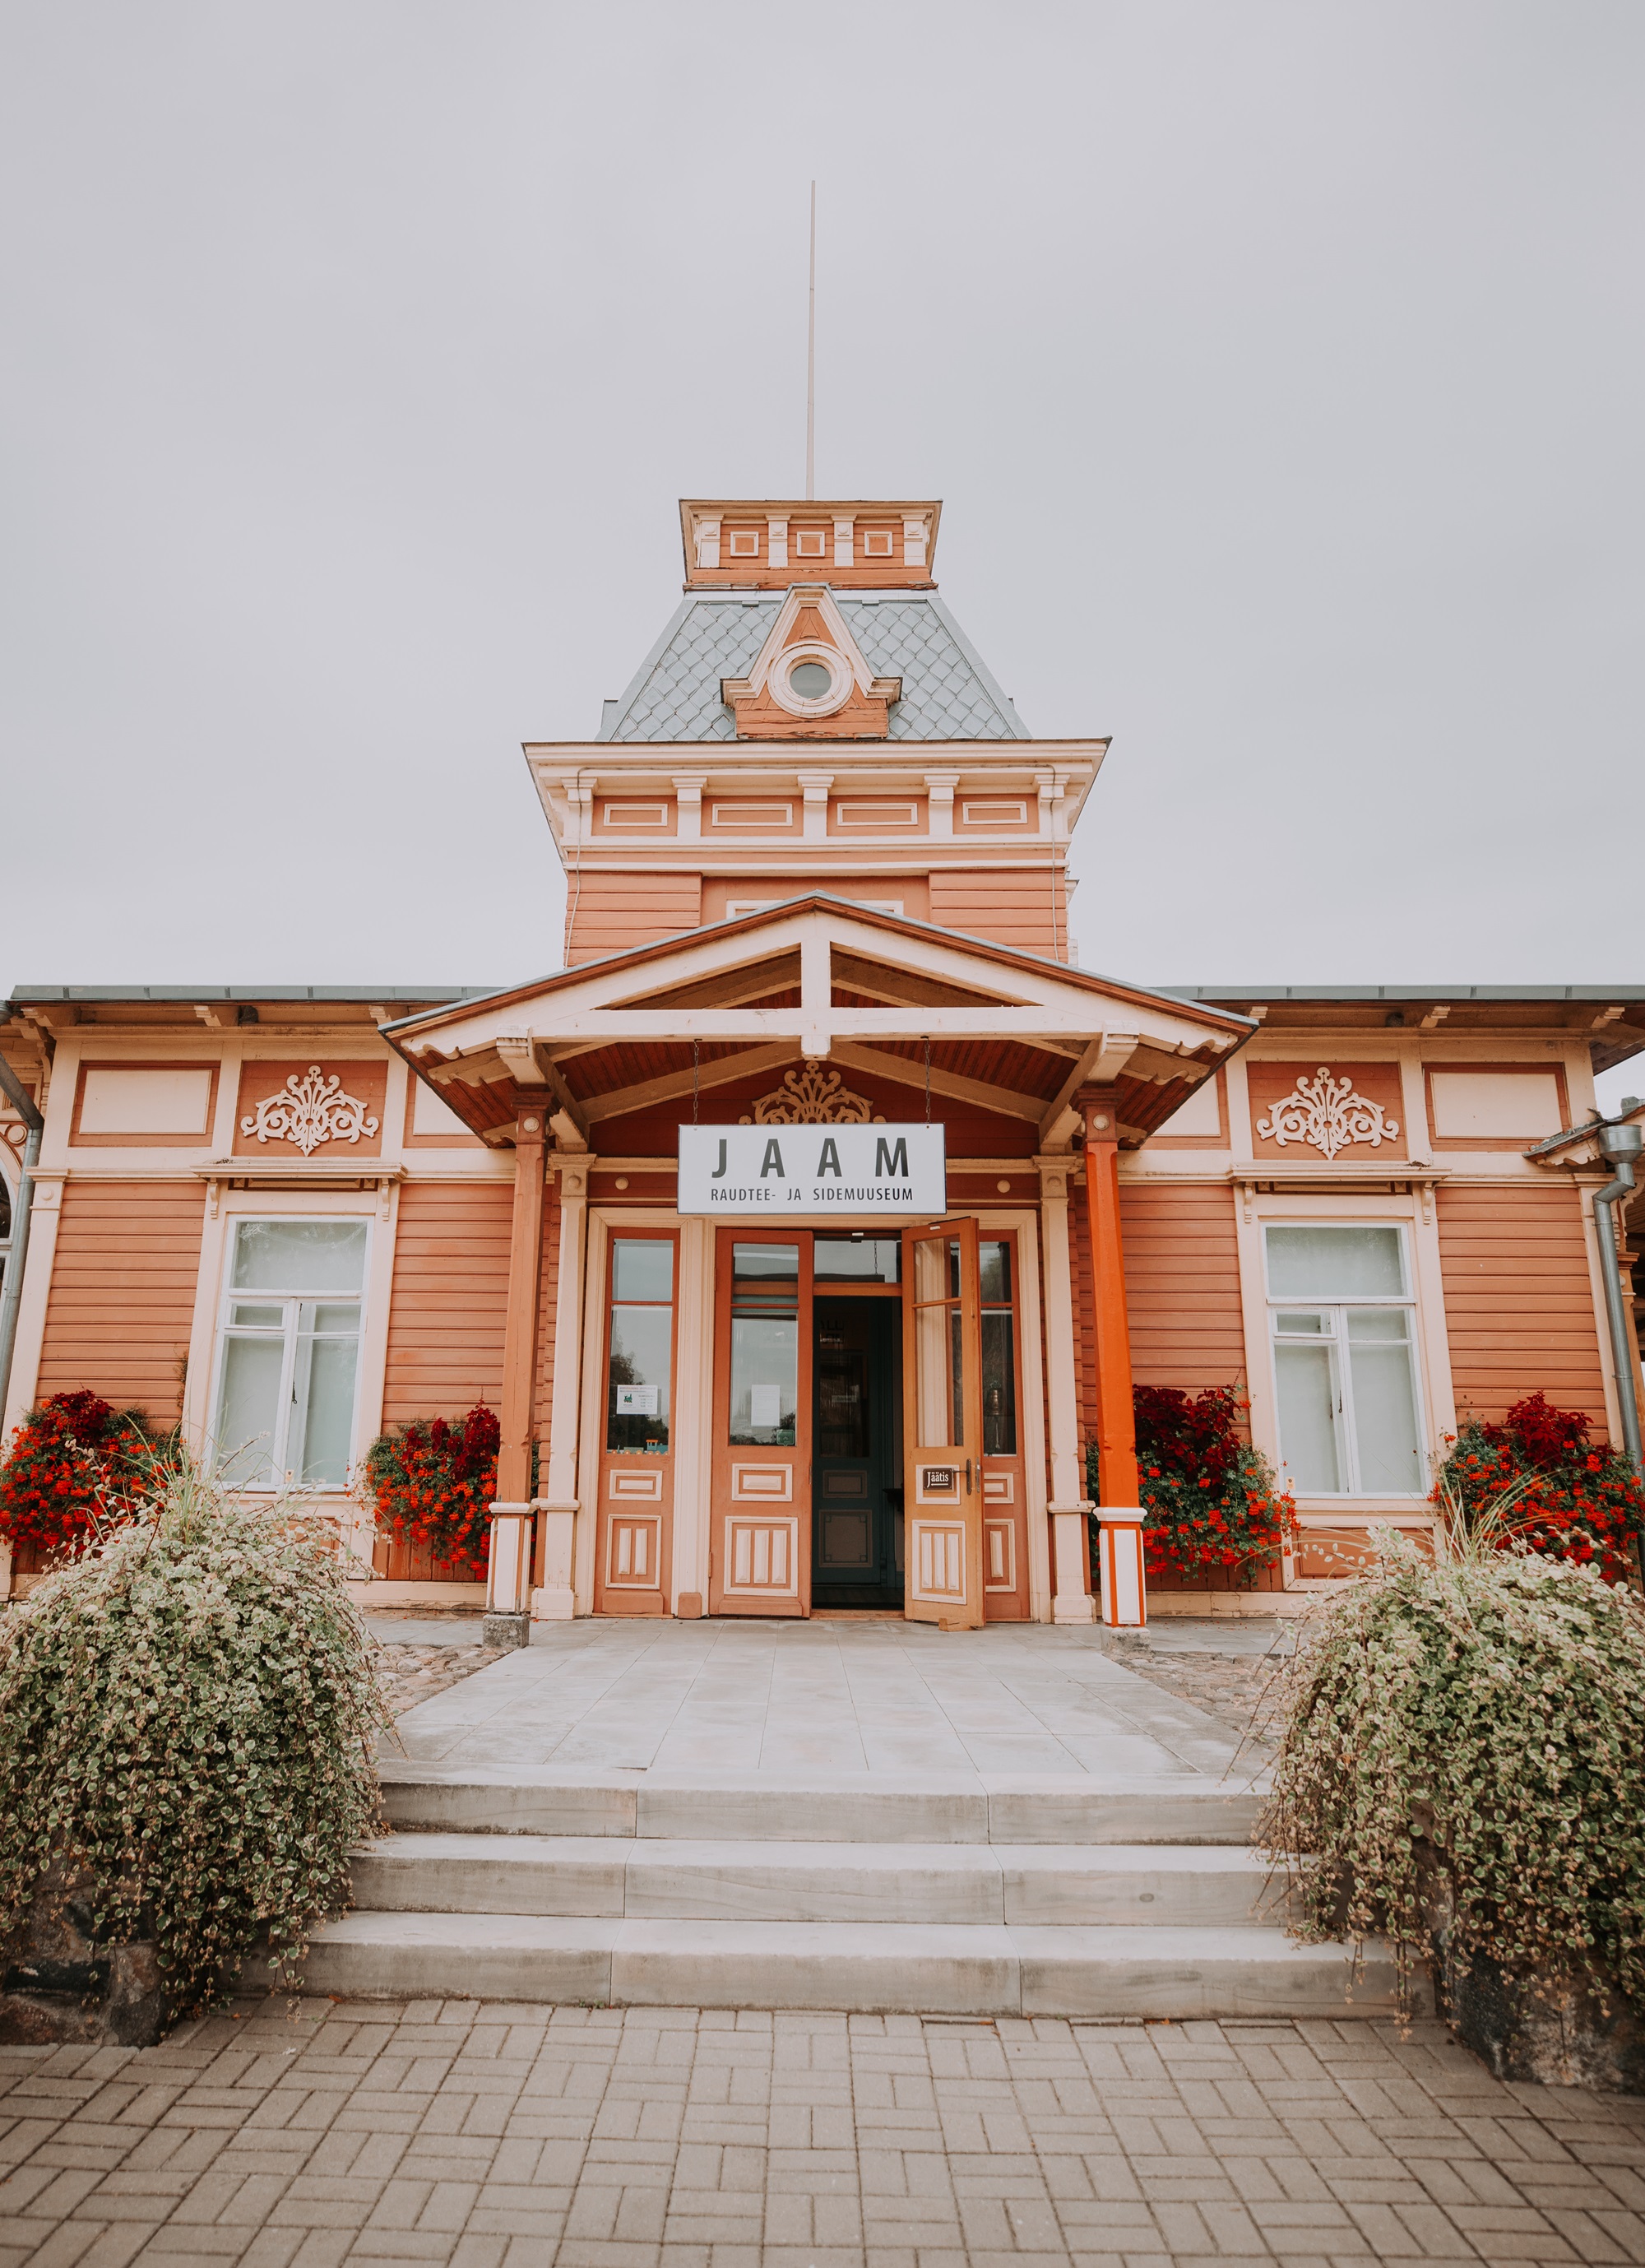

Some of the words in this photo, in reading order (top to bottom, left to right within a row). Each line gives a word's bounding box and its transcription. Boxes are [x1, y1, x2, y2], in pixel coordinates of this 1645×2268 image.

[711, 1138, 910, 1178] JAAM
[711, 1189, 776, 1201] RAUDTEE-
[787, 1189, 802, 1201] JA
[813, 1188, 913, 1201] SIDEMUUSEUM
[926, 1471, 949, 1488] Jäätis
